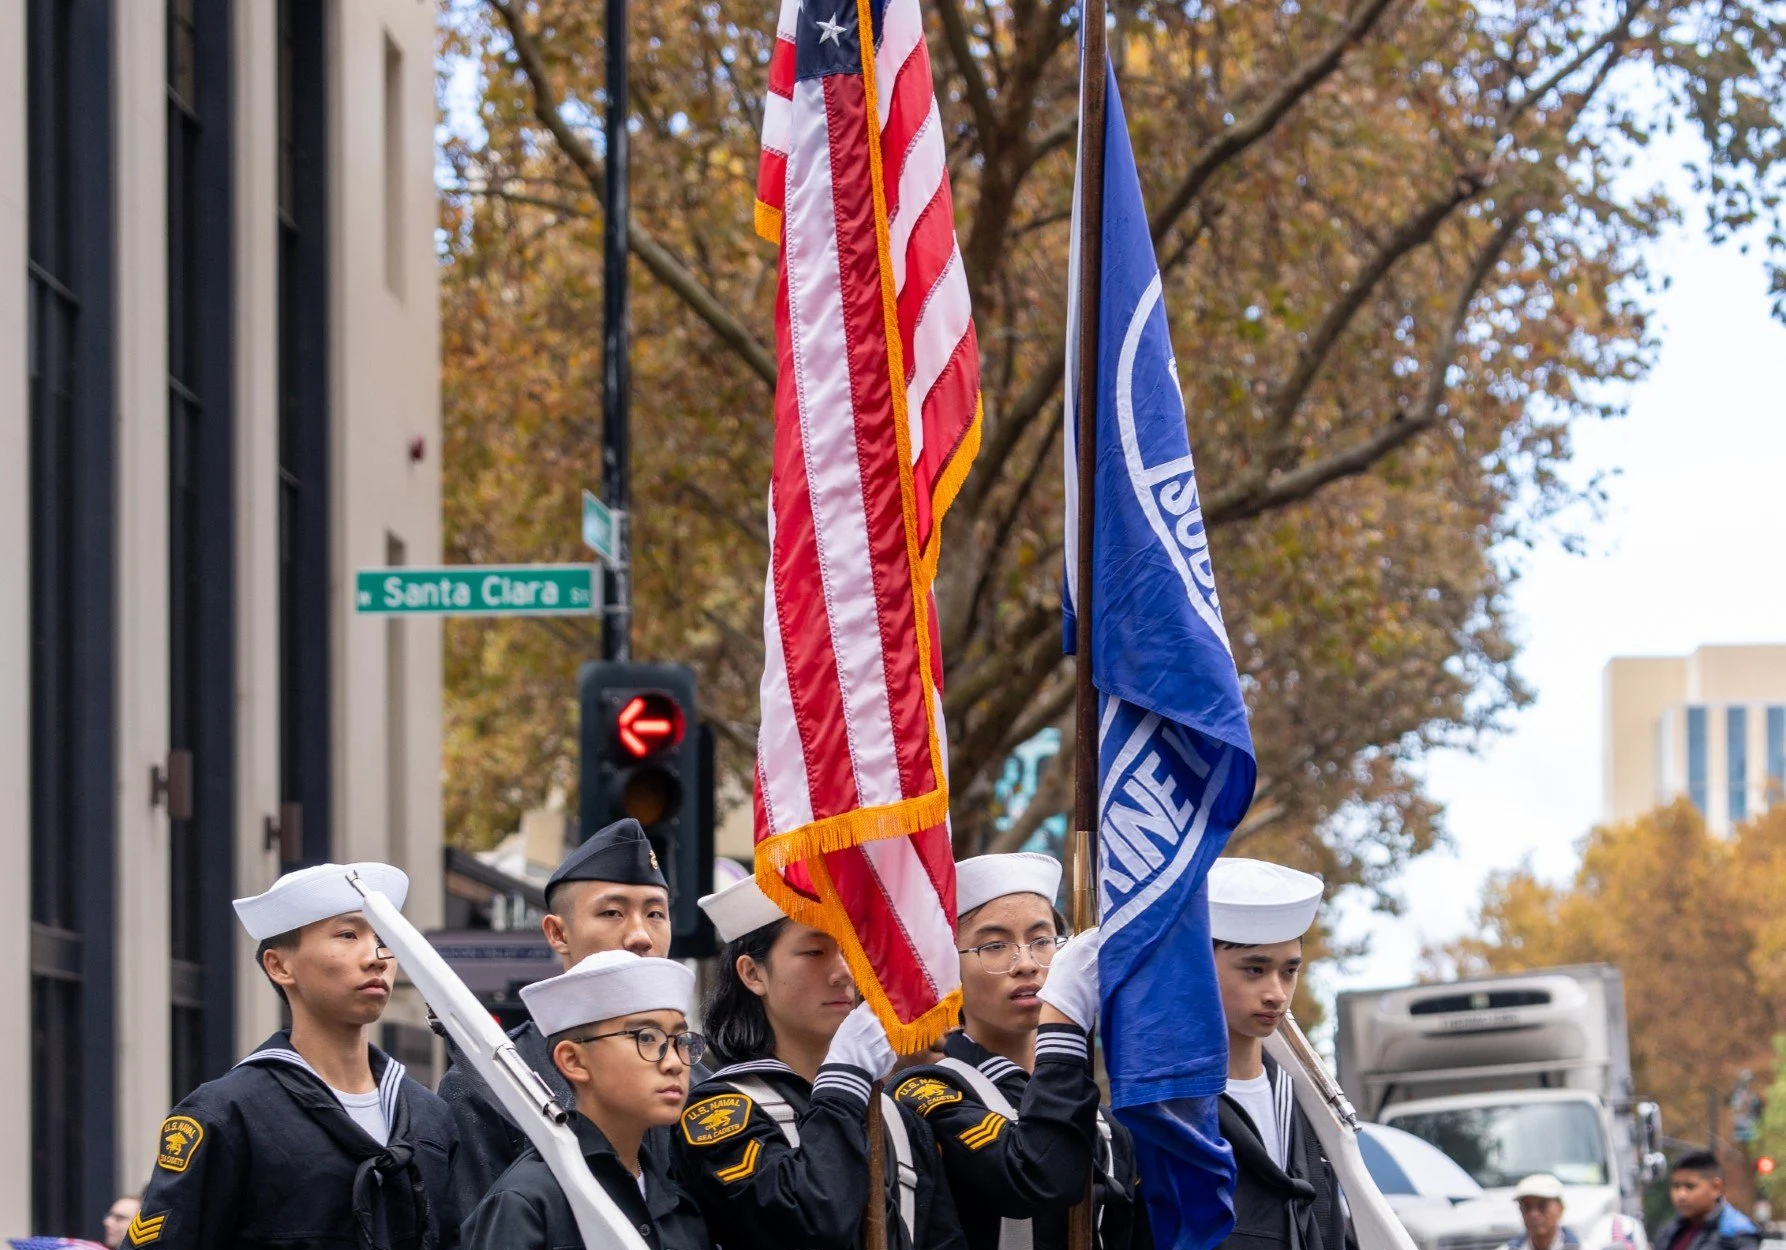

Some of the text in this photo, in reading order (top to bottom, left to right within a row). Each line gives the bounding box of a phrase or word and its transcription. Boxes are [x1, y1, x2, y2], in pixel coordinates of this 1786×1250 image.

[383, 576, 471, 607] Santa
[481, 575, 559, 606] Clara
[688, 1098, 741, 1120] U.S. NAVAL
[697, 1123, 741, 1142] SEA CADETS
